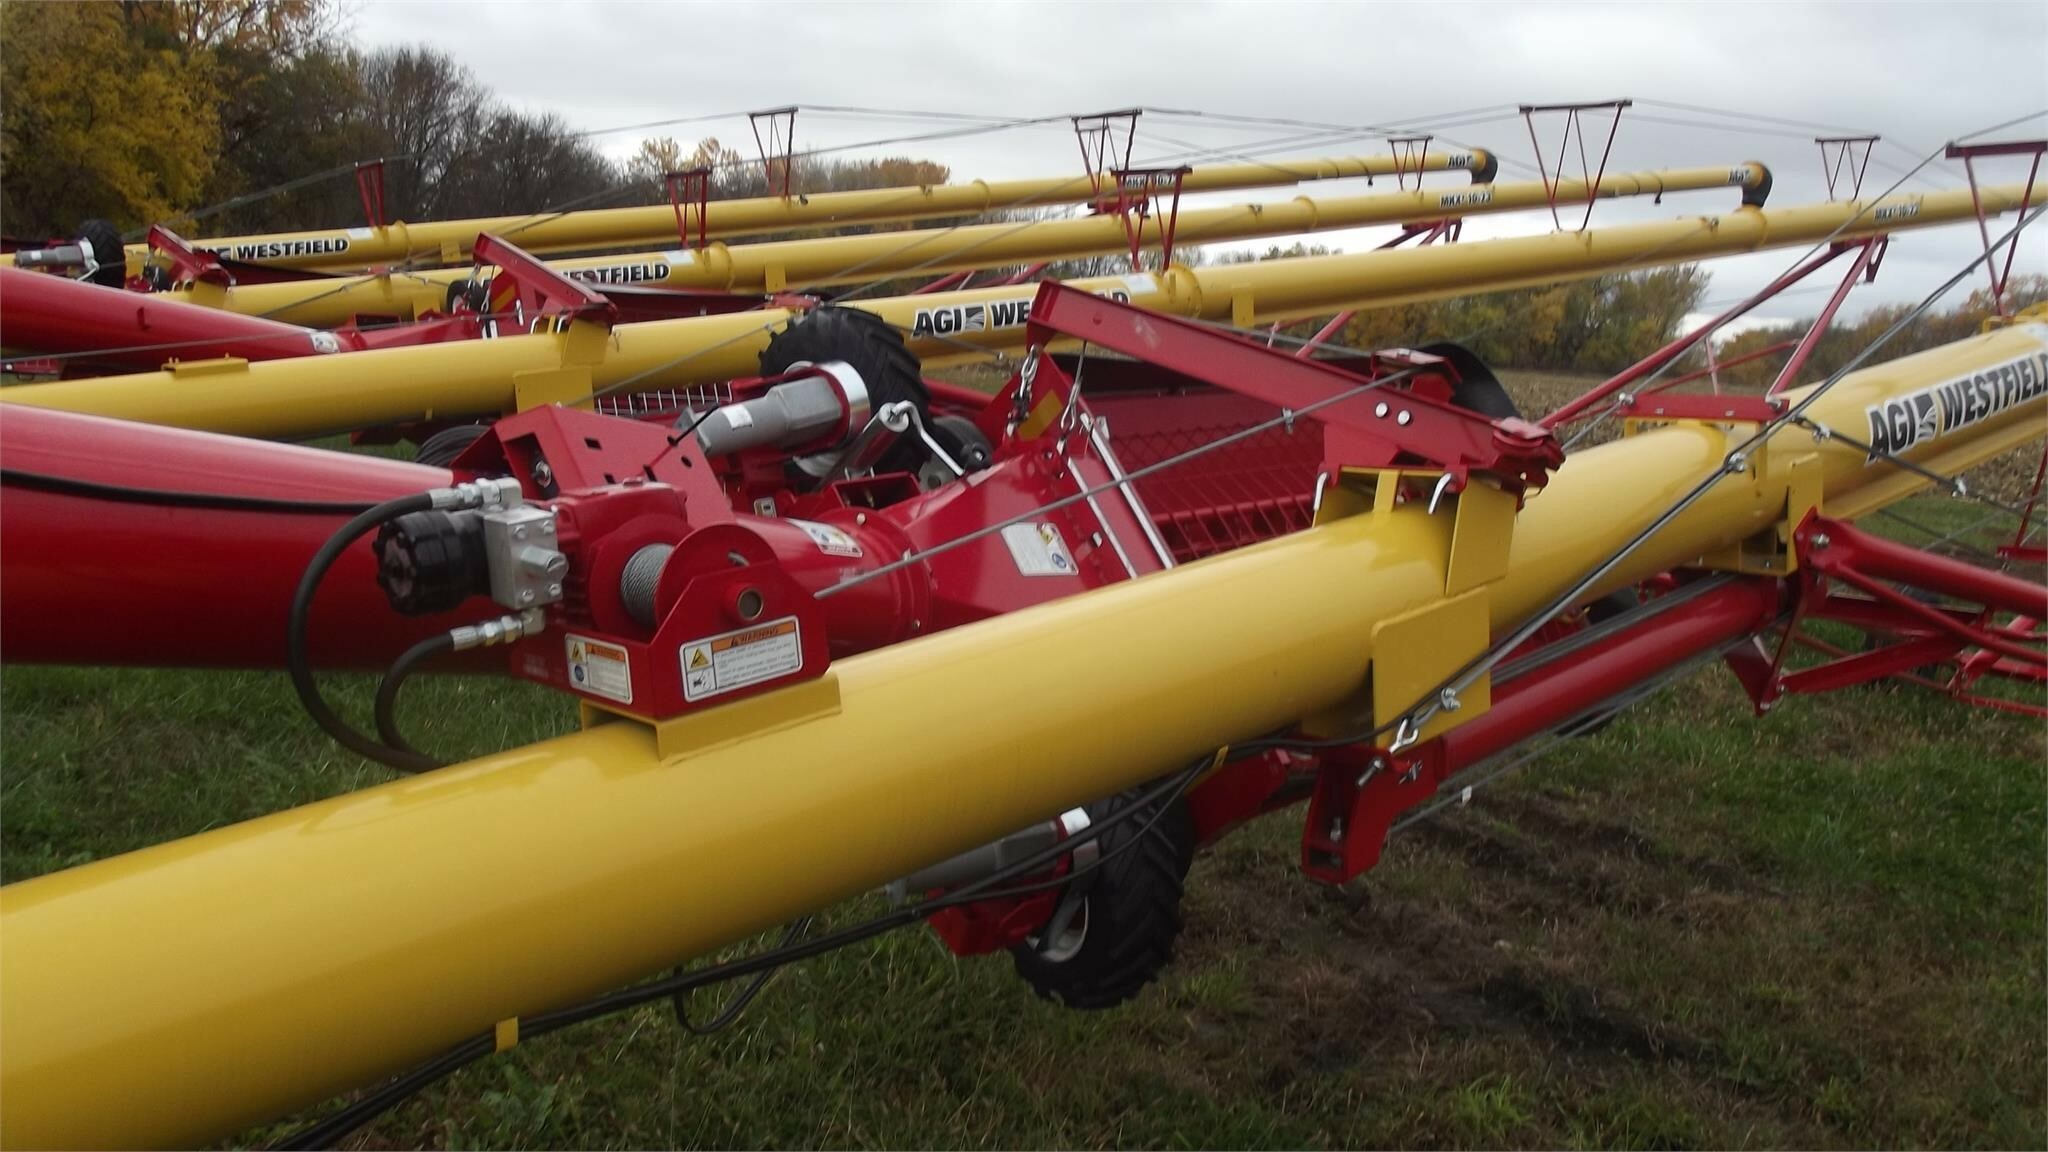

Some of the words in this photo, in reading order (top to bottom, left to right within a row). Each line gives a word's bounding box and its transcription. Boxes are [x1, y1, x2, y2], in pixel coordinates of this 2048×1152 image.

[237, 239, 348, 260] WESTFIELD
[562, 264, 670, 284] ESTFIELD
[912, 303, 962, 338] AGI
[1868, 399, 1917, 462] AGI
